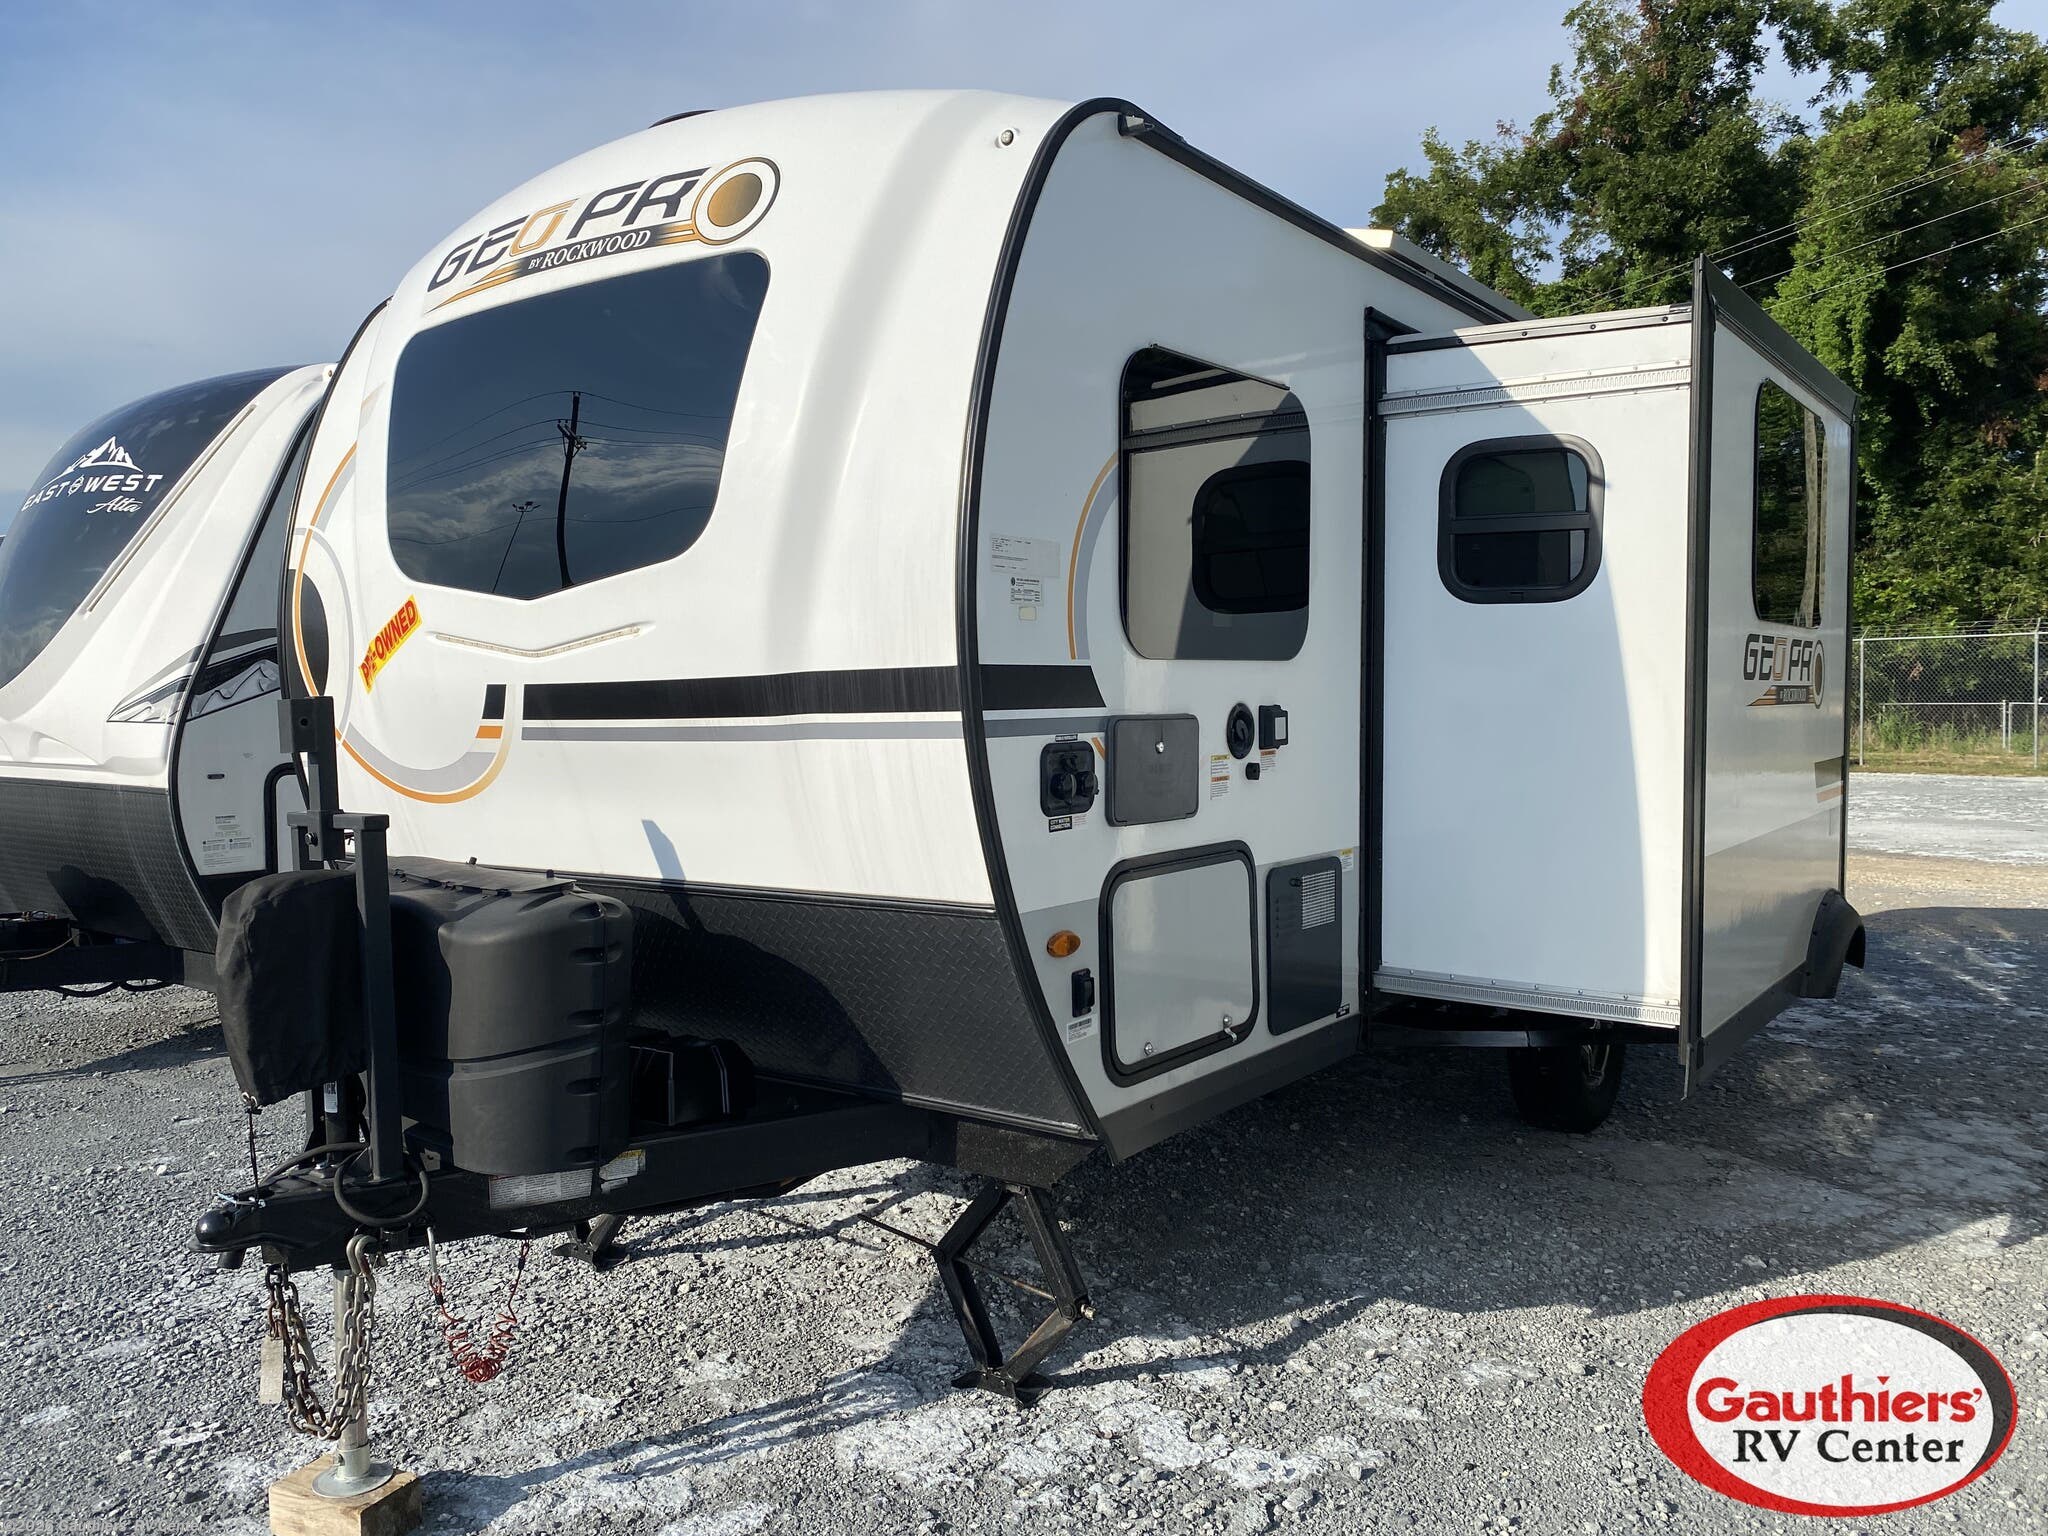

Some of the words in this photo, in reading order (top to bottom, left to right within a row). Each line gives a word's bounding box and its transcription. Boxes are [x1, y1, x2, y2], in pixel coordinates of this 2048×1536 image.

[427, 198, 580, 292] GEO
[565, 157, 780, 245] PRO
[528, 257, 543, 270] BY
[542, 230, 651, 268] ROCKWOOD
[21, 480, 71, 512] EAST
[83, 474, 164, 493] WEST
[87, 496, 144, 514] Alta
[1743, 633, 1788, 681] GEO
[1788, 639, 1826, 709] PRO
